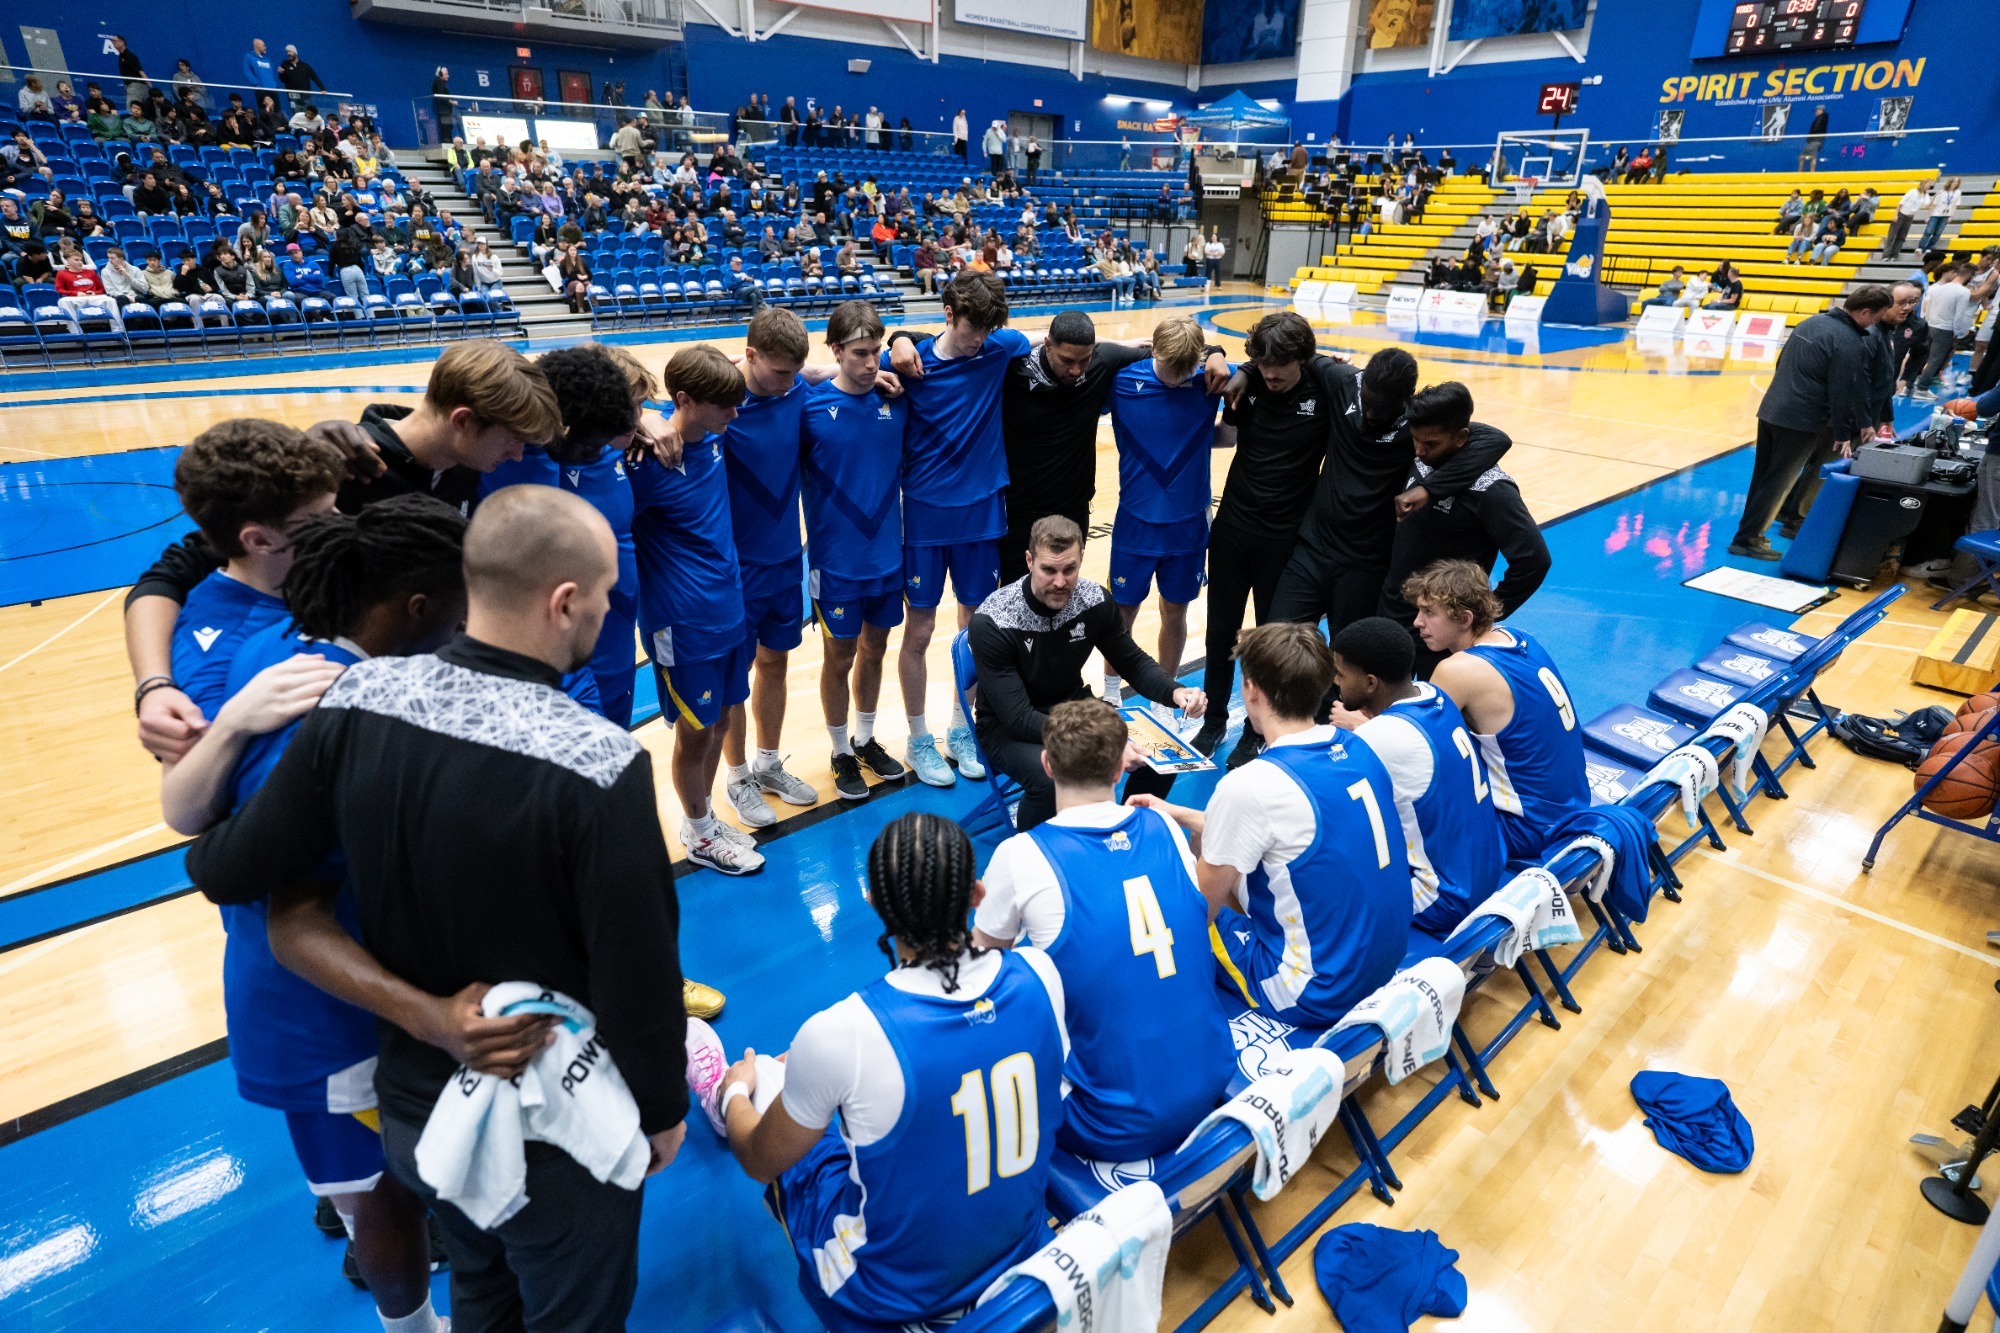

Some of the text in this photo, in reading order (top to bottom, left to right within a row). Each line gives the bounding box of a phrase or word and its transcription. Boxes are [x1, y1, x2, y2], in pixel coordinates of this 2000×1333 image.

[1846, 2, 1859, 17] 0
[965, 13, 1078, 36] WOMEN'S BASKETBALL CONFERENCE CHAMPIONS
[102, 39, 119, 56] A
[477, 73, 490, 87] B
[1659, 57, 1926, 104] SPIRIT SECTION
[1542, 87, 1570, 110] 24
[1714, 98, 1748, 107] Established
[1783, 95, 1806, 103] Alumni
[1806, 93, 1844, 101] Association
[1117, 120, 1142, 131] SNACK
[1537, 666, 1576, 732] 9
[1451, 726, 1489, 804] 2
[1346, 778, 1391, 870] 1
[1123, 874, 1177, 979] 4
[951, 1051, 1040, 1197] 10
